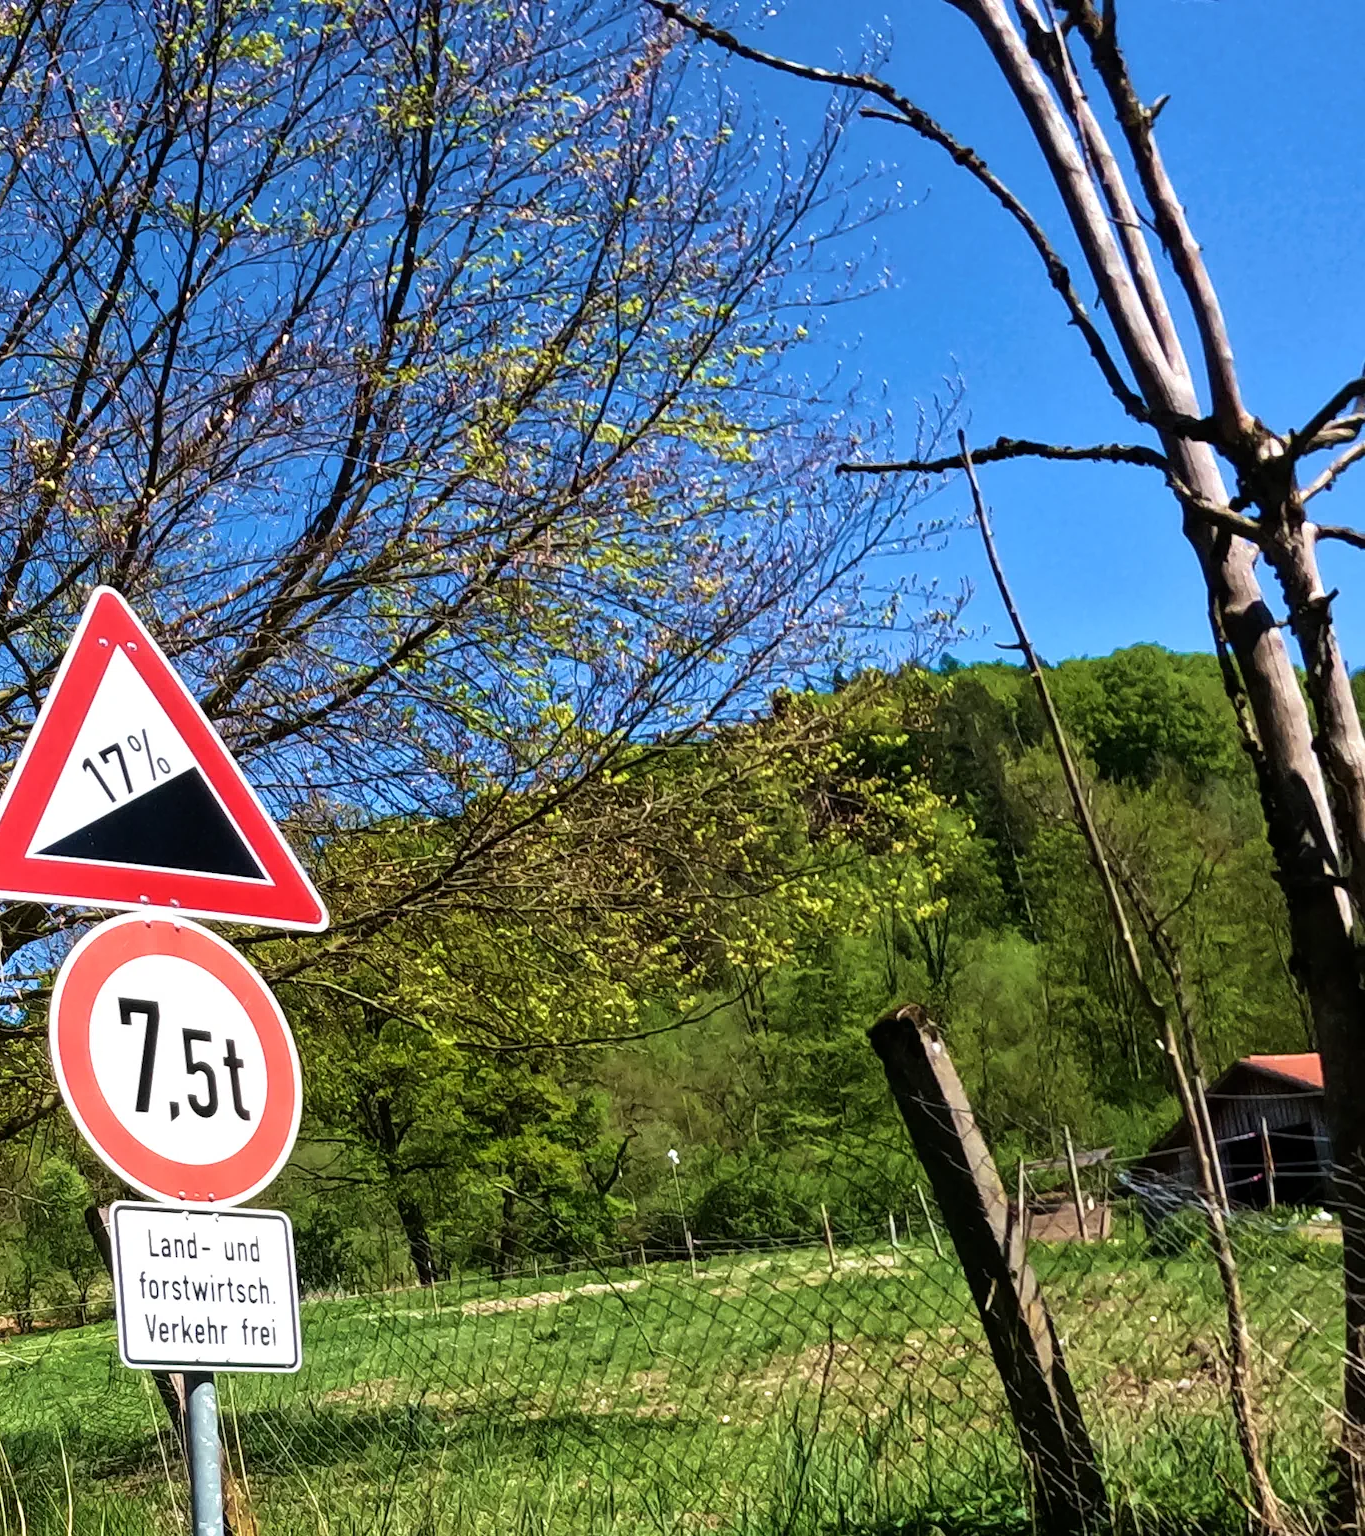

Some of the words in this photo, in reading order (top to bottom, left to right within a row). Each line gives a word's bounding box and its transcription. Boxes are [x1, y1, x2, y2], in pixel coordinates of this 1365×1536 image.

[82, 728, 171, 803] 17%
[118, 997, 251, 1121] 7,5t
[148, 1229, 211, 1259] Land-
[224, 1236, 260, 1262] und
[139, 1271, 276, 1304] forstwirtsch.
[145, 1314, 228, 1345] Verkehr
[241, 1318, 277, 1346] frei
